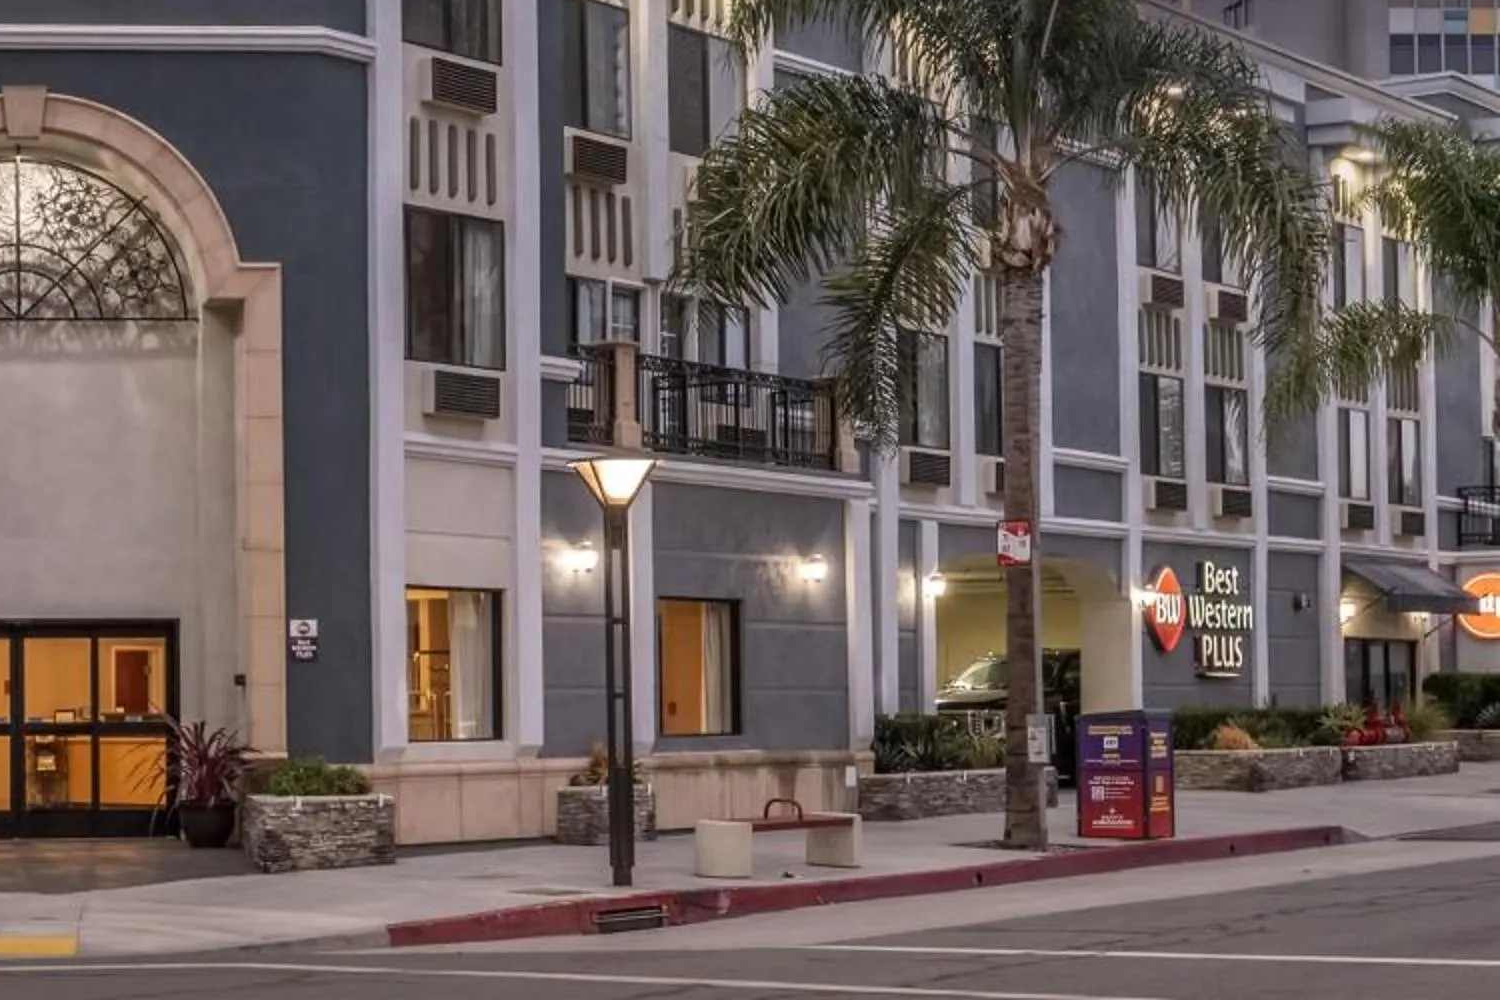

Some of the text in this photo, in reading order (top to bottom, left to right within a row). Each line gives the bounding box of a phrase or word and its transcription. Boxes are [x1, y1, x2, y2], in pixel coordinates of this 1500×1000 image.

[1204, 561, 1239, 596] Best
[1156, 593, 1181, 625] BW
[1188, 594, 1253, 630] Western
[1201, 634, 1243, 668] PLUS
